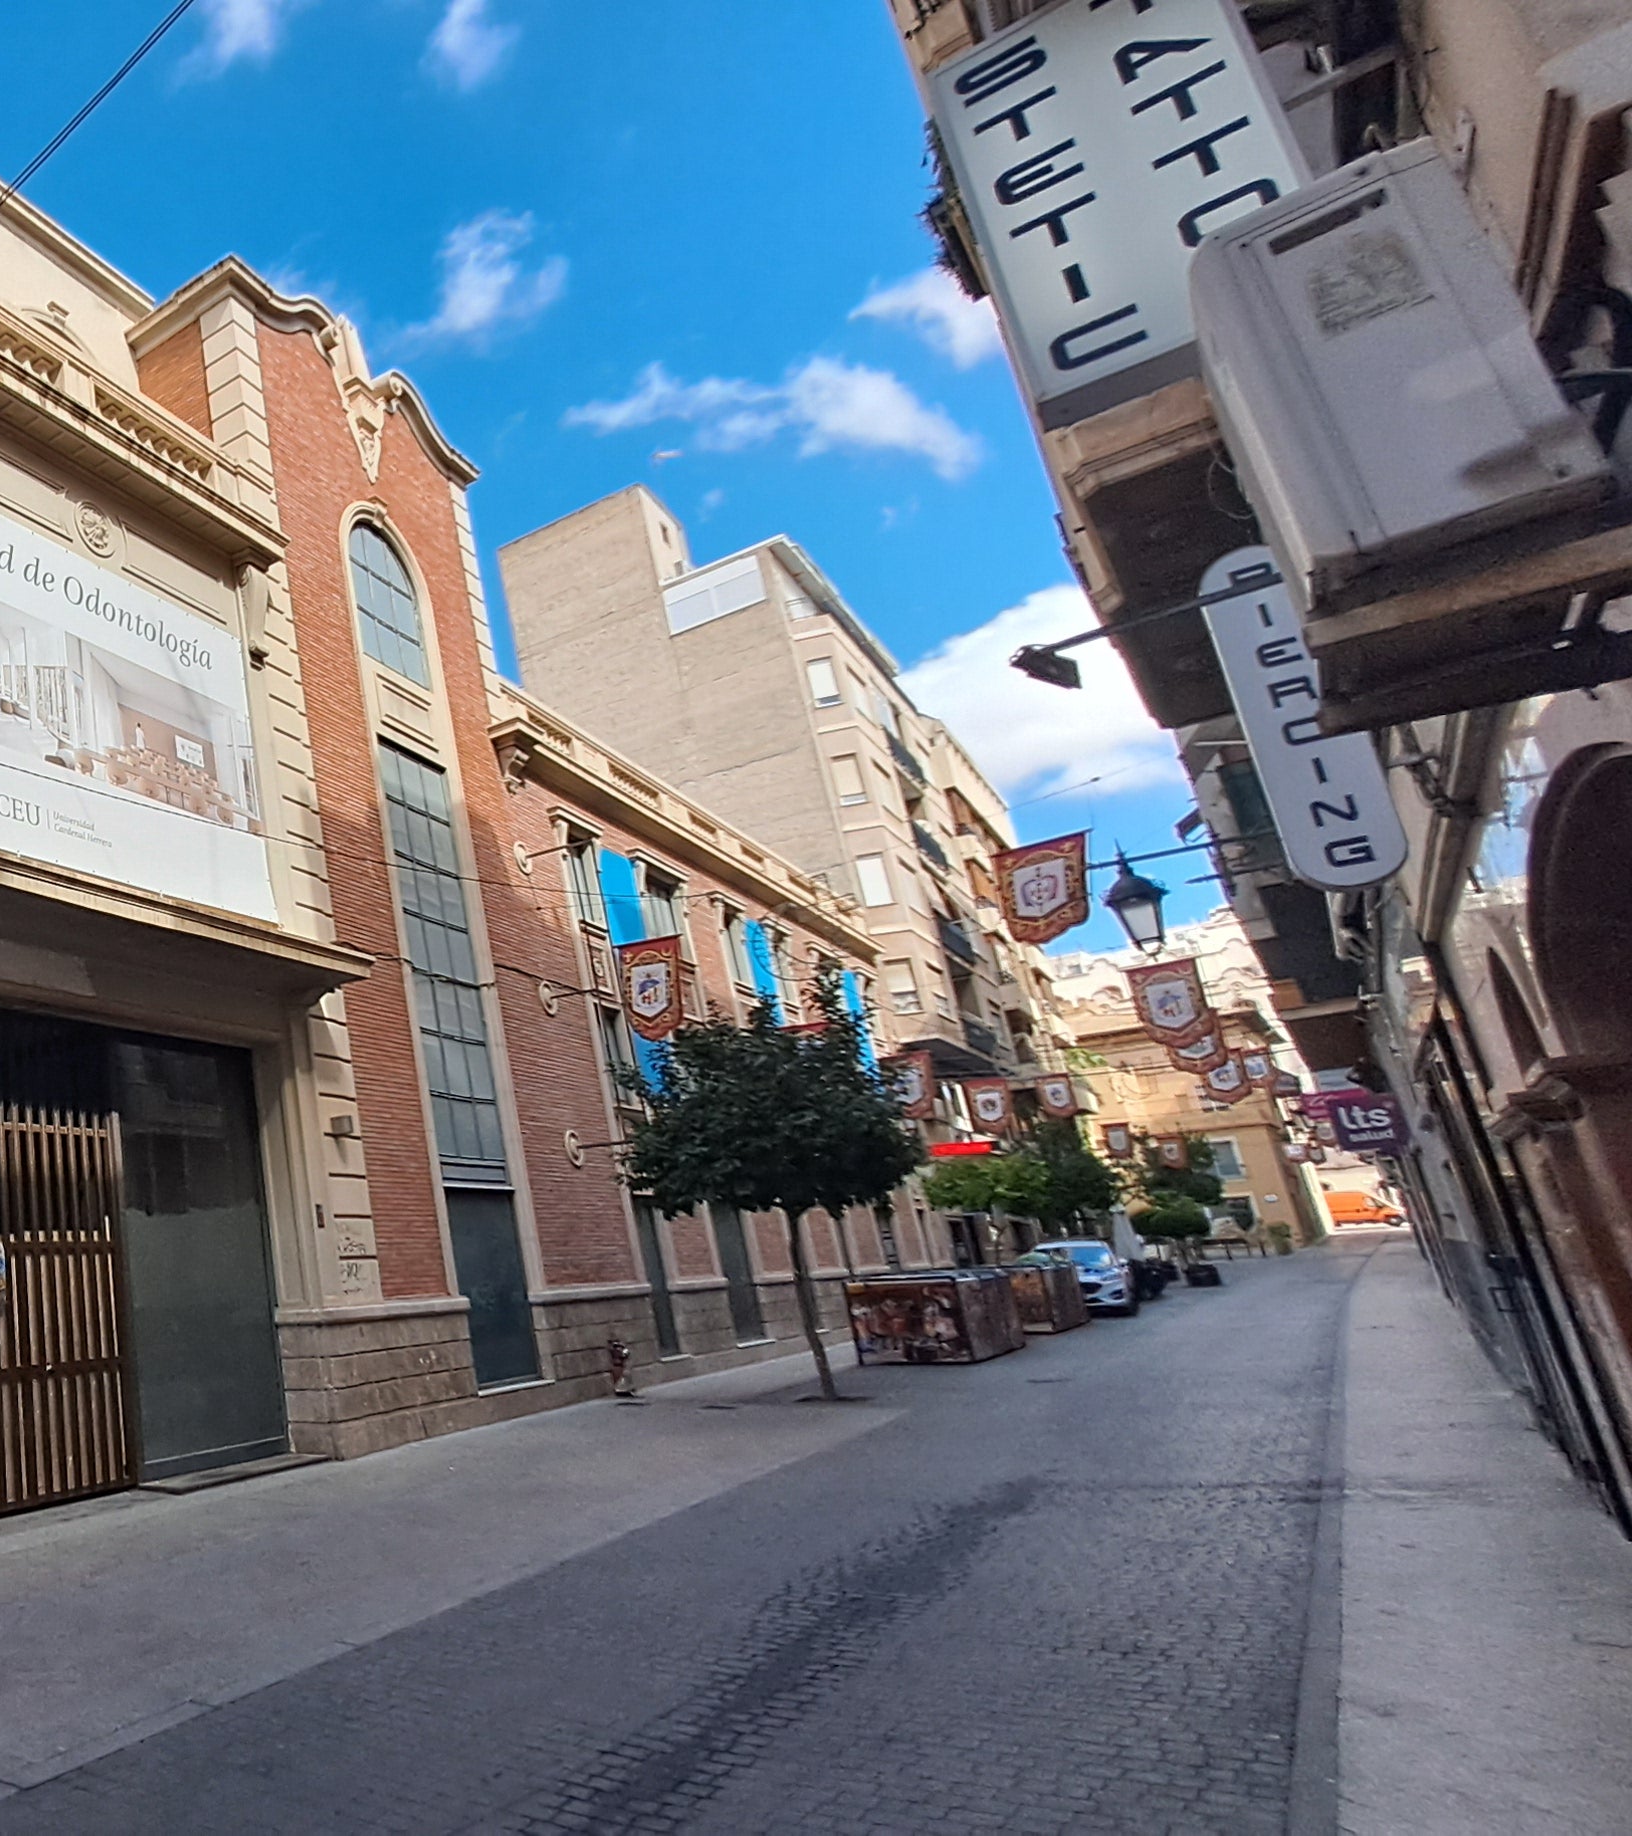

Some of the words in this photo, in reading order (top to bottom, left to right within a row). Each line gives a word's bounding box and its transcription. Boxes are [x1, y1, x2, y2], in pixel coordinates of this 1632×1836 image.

[23, 556, 56, 592] de
[63, 575, 213, 670] Odontología
[1228, 561, 1376, 868] PIERCING
[1349, 1128, 1394, 1142] salud
